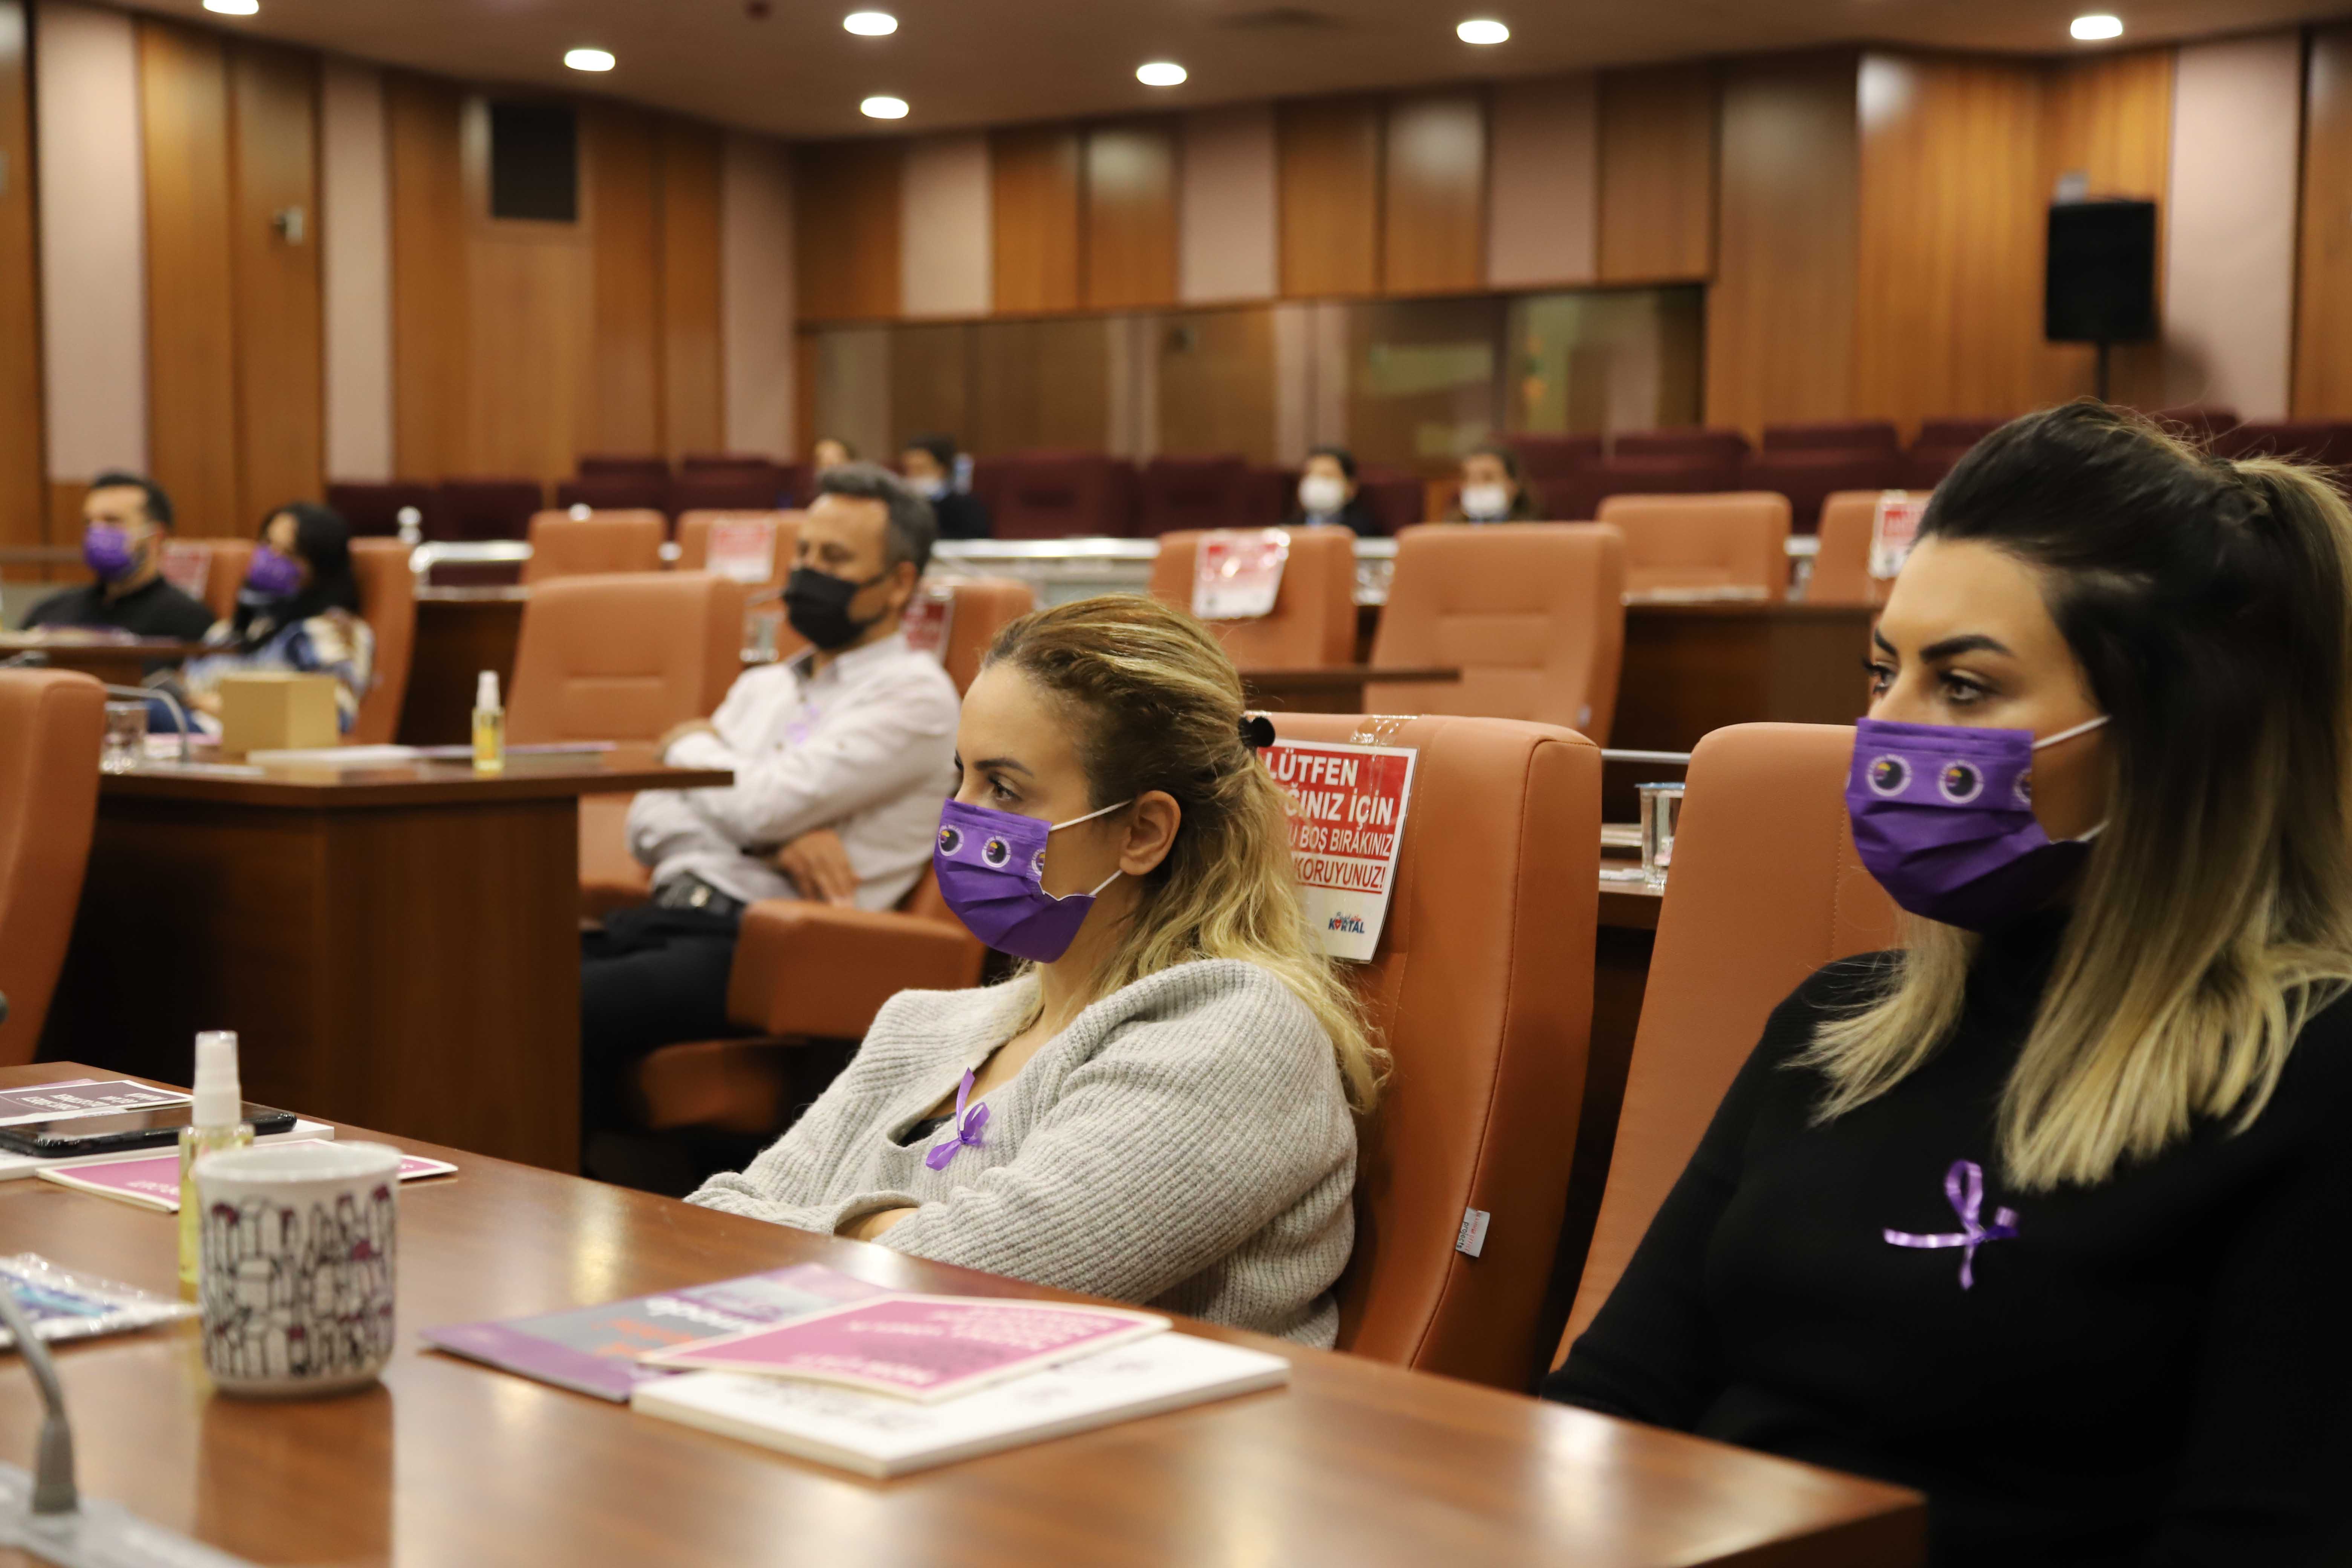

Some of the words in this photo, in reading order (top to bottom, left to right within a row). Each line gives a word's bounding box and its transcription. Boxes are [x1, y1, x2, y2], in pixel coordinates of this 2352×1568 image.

[1265, 748, 1359, 787] LÜTFEN
[1284, 782, 1345, 821] ĞINIZ
[1348, 788, 1394, 831] İÇİN
[1300, 825, 1328, 854] BOŞ
[1329, 828, 1393, 857] BIRAKINIZ
[1294, 857, 1386, 889] KORUYUNUZ!
[1456, 1221, 1469, 1249] projects
